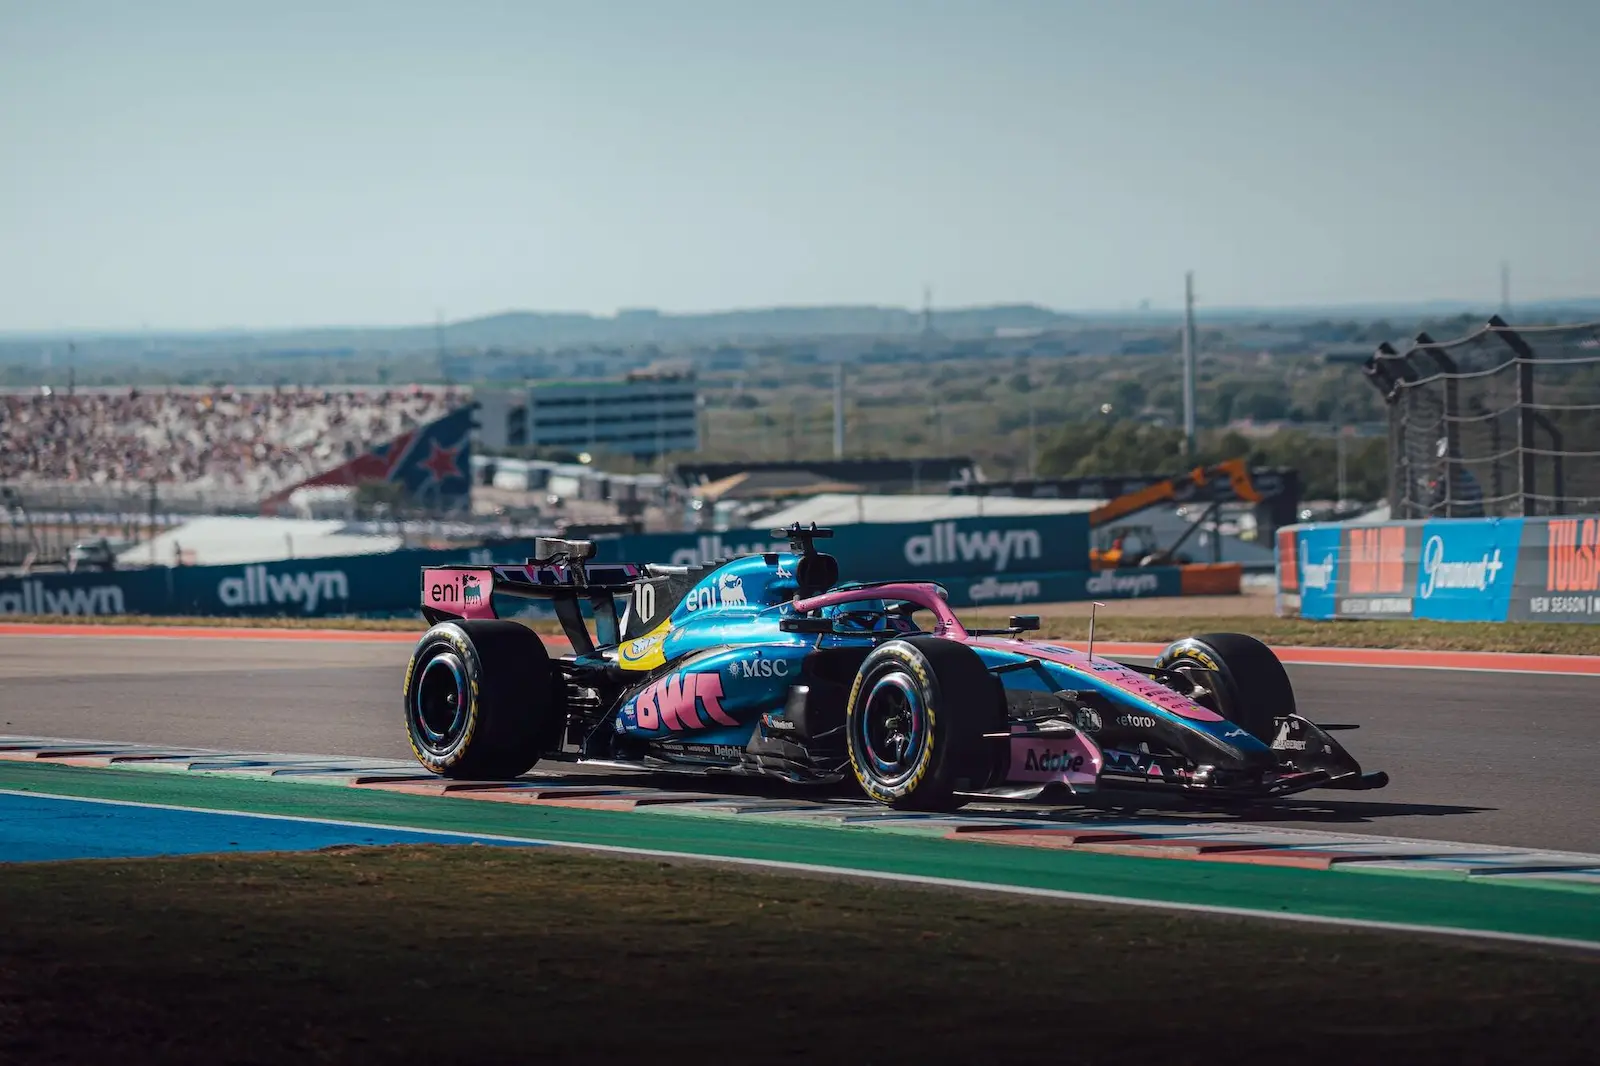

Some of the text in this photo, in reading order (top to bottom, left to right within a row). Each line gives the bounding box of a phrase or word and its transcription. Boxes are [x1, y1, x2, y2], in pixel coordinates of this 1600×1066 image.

[671, 535, 792, 565] all
[903, 523, 1041, 571] allwyn
[1547, 519, 1600, 591] TULS
[218, 565, 348, 612] allwyn
[431, 576, 459, 602] eni
[686, 580, 716, 611] eni
[968, 577, 1040, 601] allwyn
[1086, 567, 1157, 597] allwyn
[0, 581, 125, 616] allwyn
[634, 582, 656, 624] 10
[1530, 597, 1549, 613] NEW
[742, 659, 788, 677] MSC
[636, 673, 740, 731] BWT
[713, 744, 742, 758] Delphi
[1024, 748, 1084, 773] Adobe
